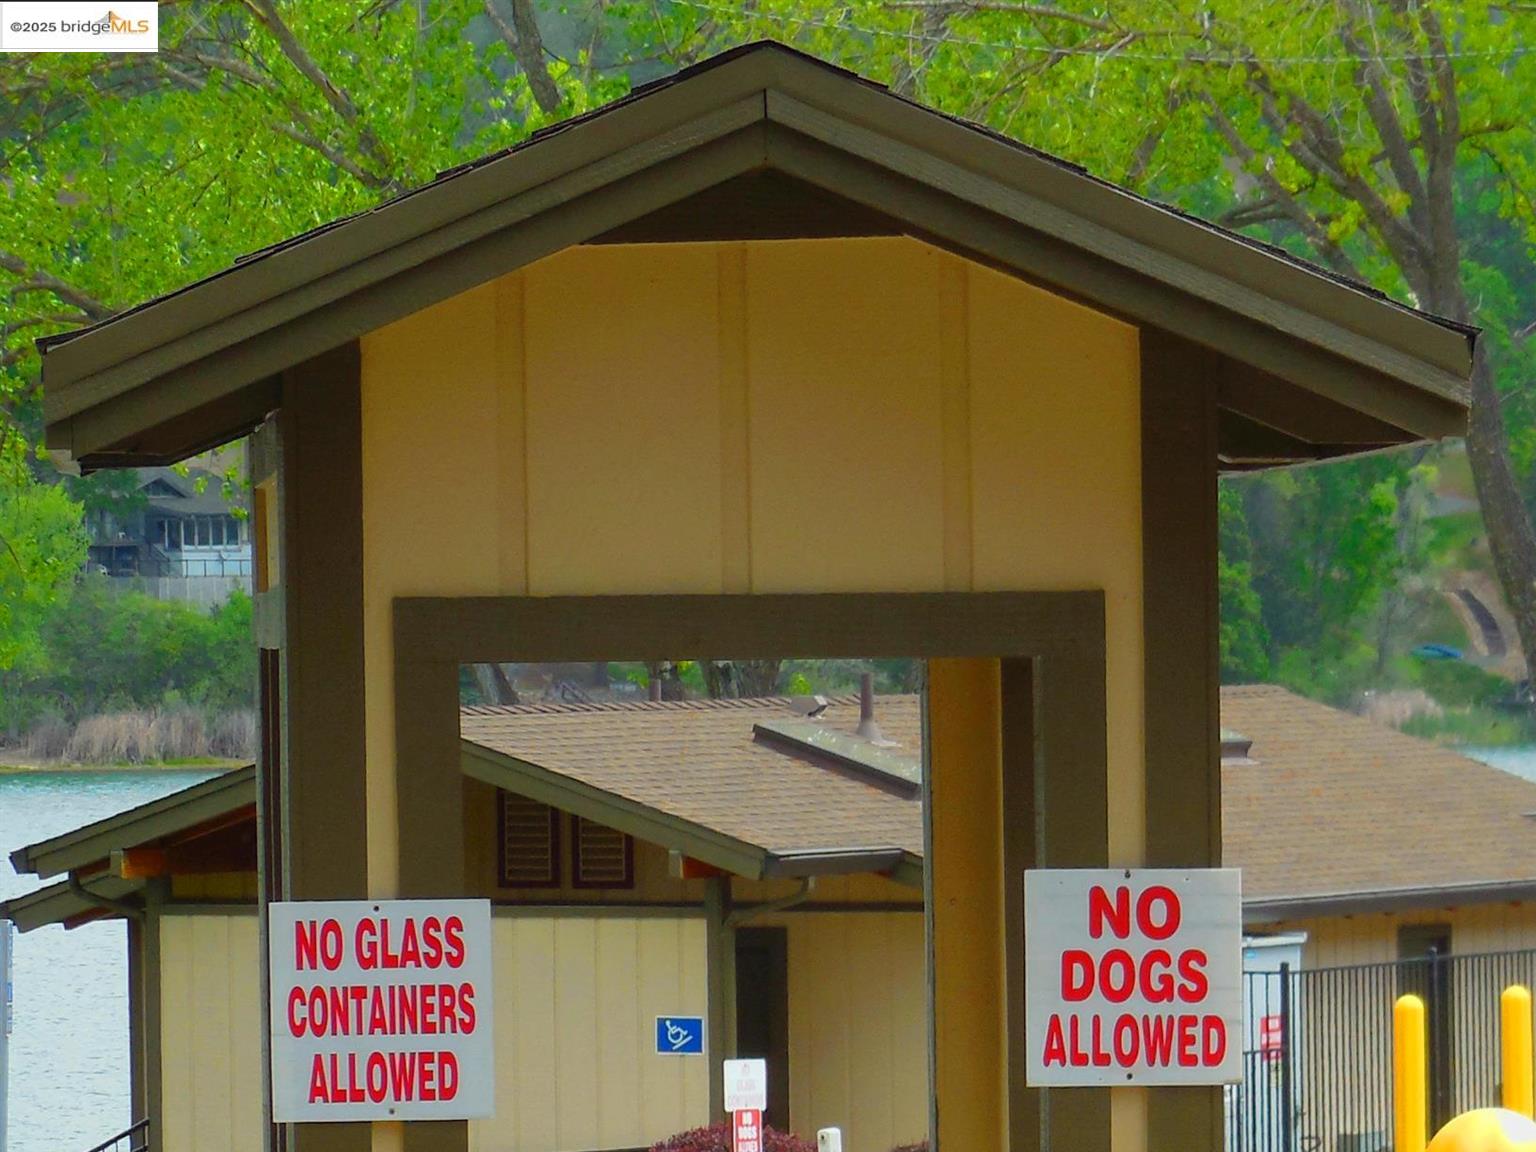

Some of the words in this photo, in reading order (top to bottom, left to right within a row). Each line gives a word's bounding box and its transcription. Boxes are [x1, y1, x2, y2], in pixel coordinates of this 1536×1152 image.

[1088, 884, 1182, 940] NO
[294, 918, 345, 972] NO
[354, 915, 466, 970] GLASS
[1060, 947, 1210, 1004] DOGS
[287, 982, 477, 1039] CONTAINERS
[1043, 1012, 1229, 1068] ALLOWED
[308, 1050, 460, 1105] ALLOWED
